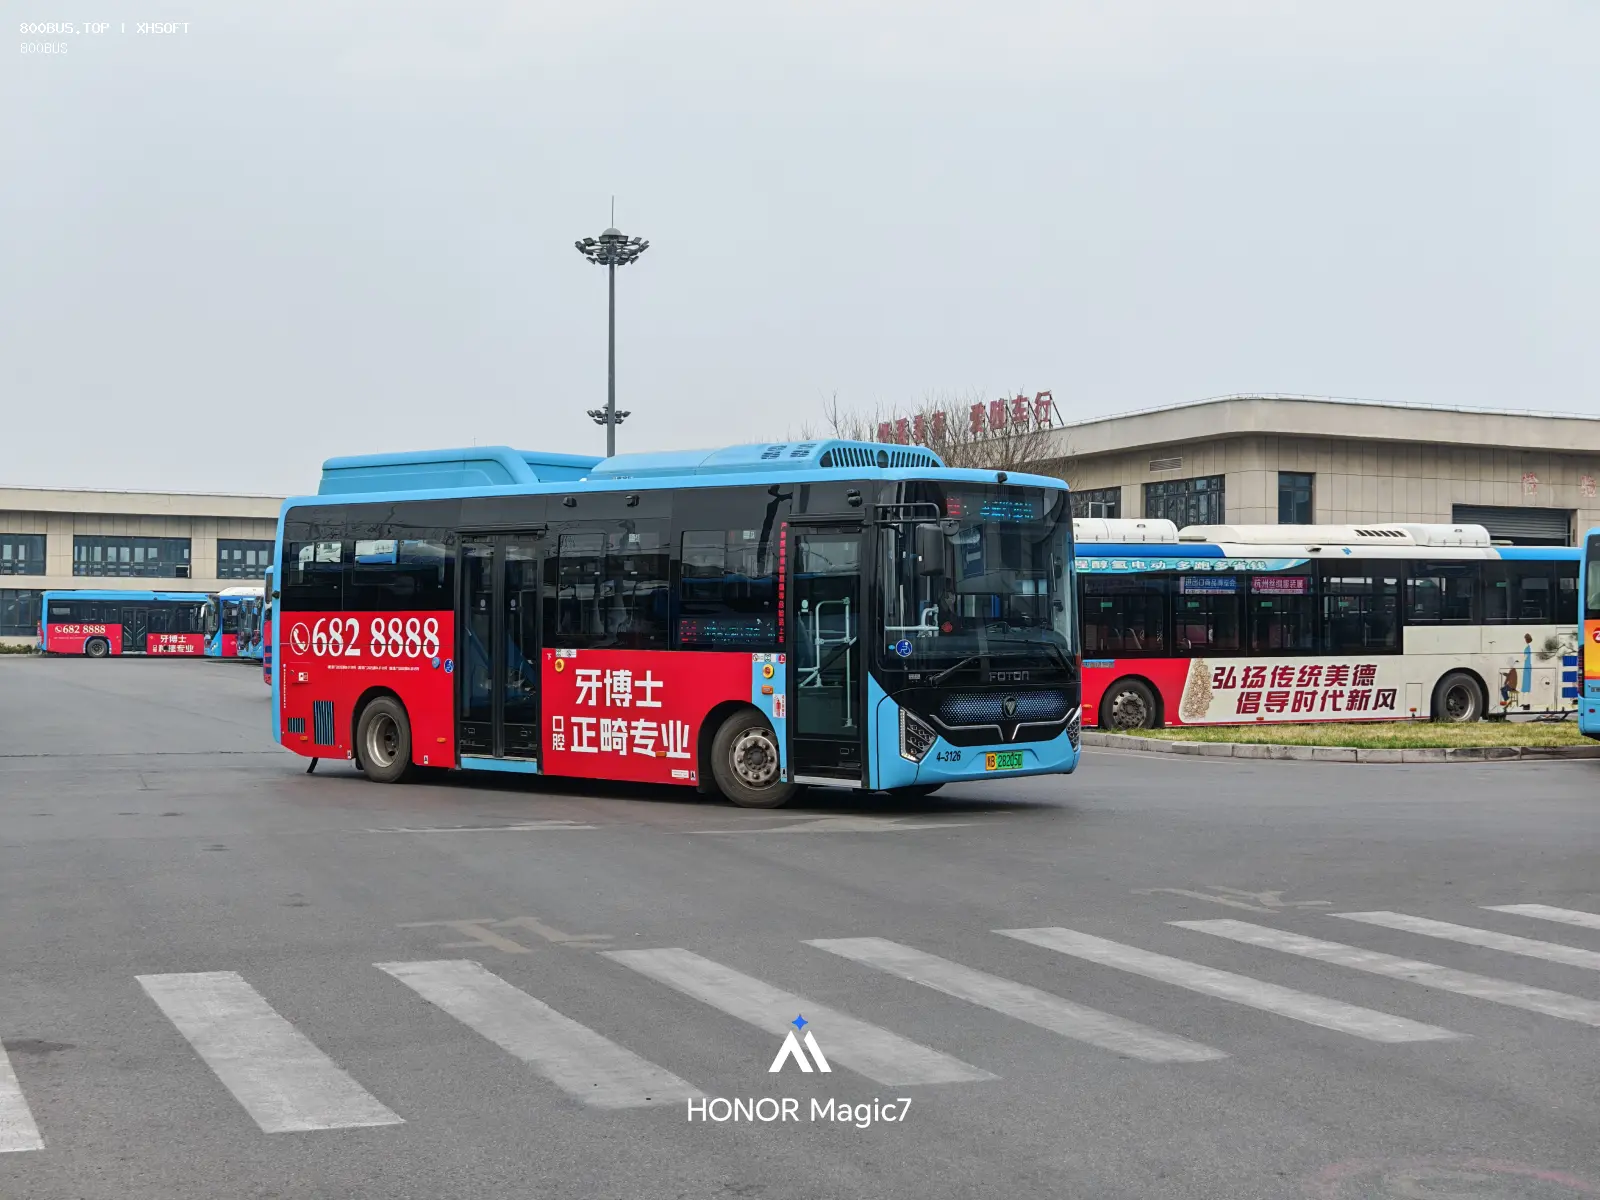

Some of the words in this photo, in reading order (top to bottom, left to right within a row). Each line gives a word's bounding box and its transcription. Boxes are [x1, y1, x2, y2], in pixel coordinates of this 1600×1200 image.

[1175, 559, 1267, 571] 多跑多省钱
[1253, 578, 1303, 589] 杭州丝绸服装展
[63, 624, 80, 634] 682
[82, 624, 106, 634] 8888
[312, 617, 361, 657] 682
[370, 617, 440, 658] 8888
[160, 635, 187, 643] 牙博士
[989, 671, 1030, 682] FOTON
[1212, 663, 1378, 690] 弘扬传统美德
[575, 668, 664, 708] 牙博士
[1236, 688, 1397, 715] 倡导时代新风
[552, 715, 565, 751] 口腔
[570, 716, 691, 759] 正畸专业
[936, 751, 961, 763] 4-3126
